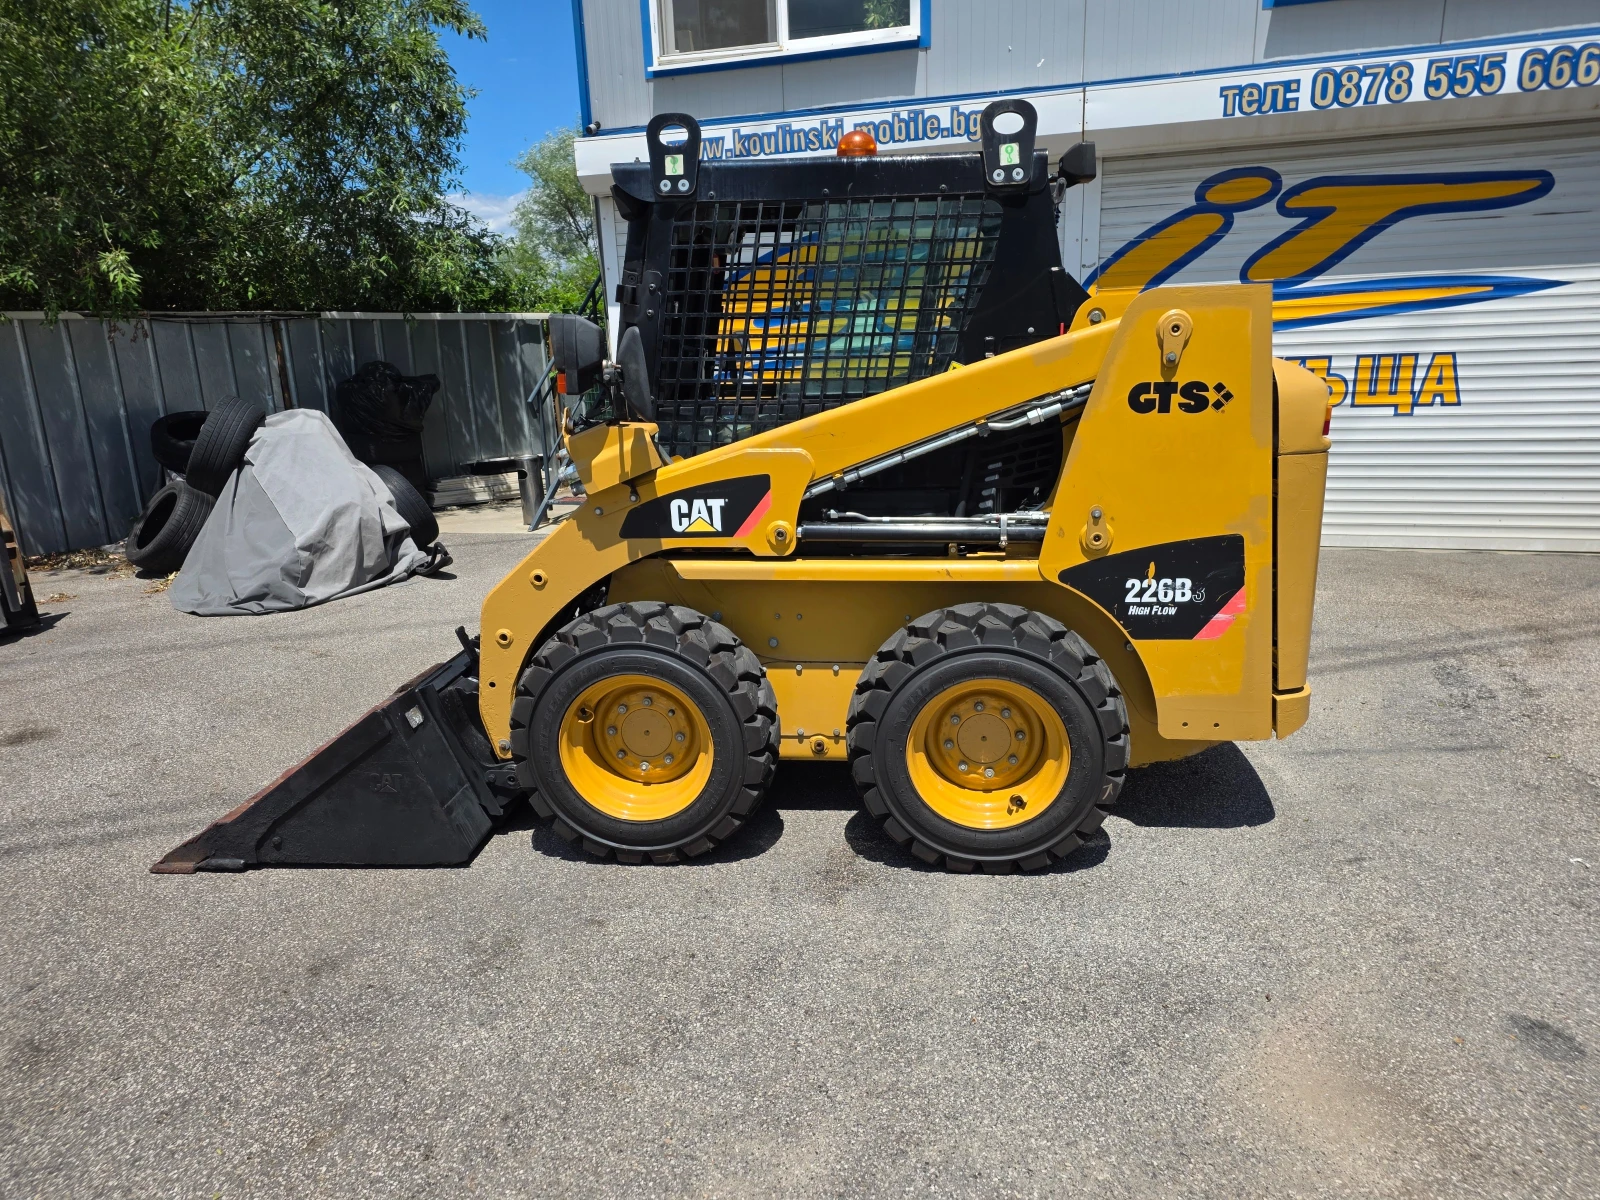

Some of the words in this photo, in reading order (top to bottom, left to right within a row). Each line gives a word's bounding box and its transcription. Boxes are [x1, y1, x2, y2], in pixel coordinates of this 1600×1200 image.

[1219, 79, 1301, 117] тел:
[1310, 60, 1414, 110] 0878
[1424, 52, 1507, 100] 555
[1517, 42, 1600, 92] 666
[1128, 381, 1210, 414] GTS
[1275, 352, 1461, 416] ЪЩА
[670, 499, 725, 532] CAT
